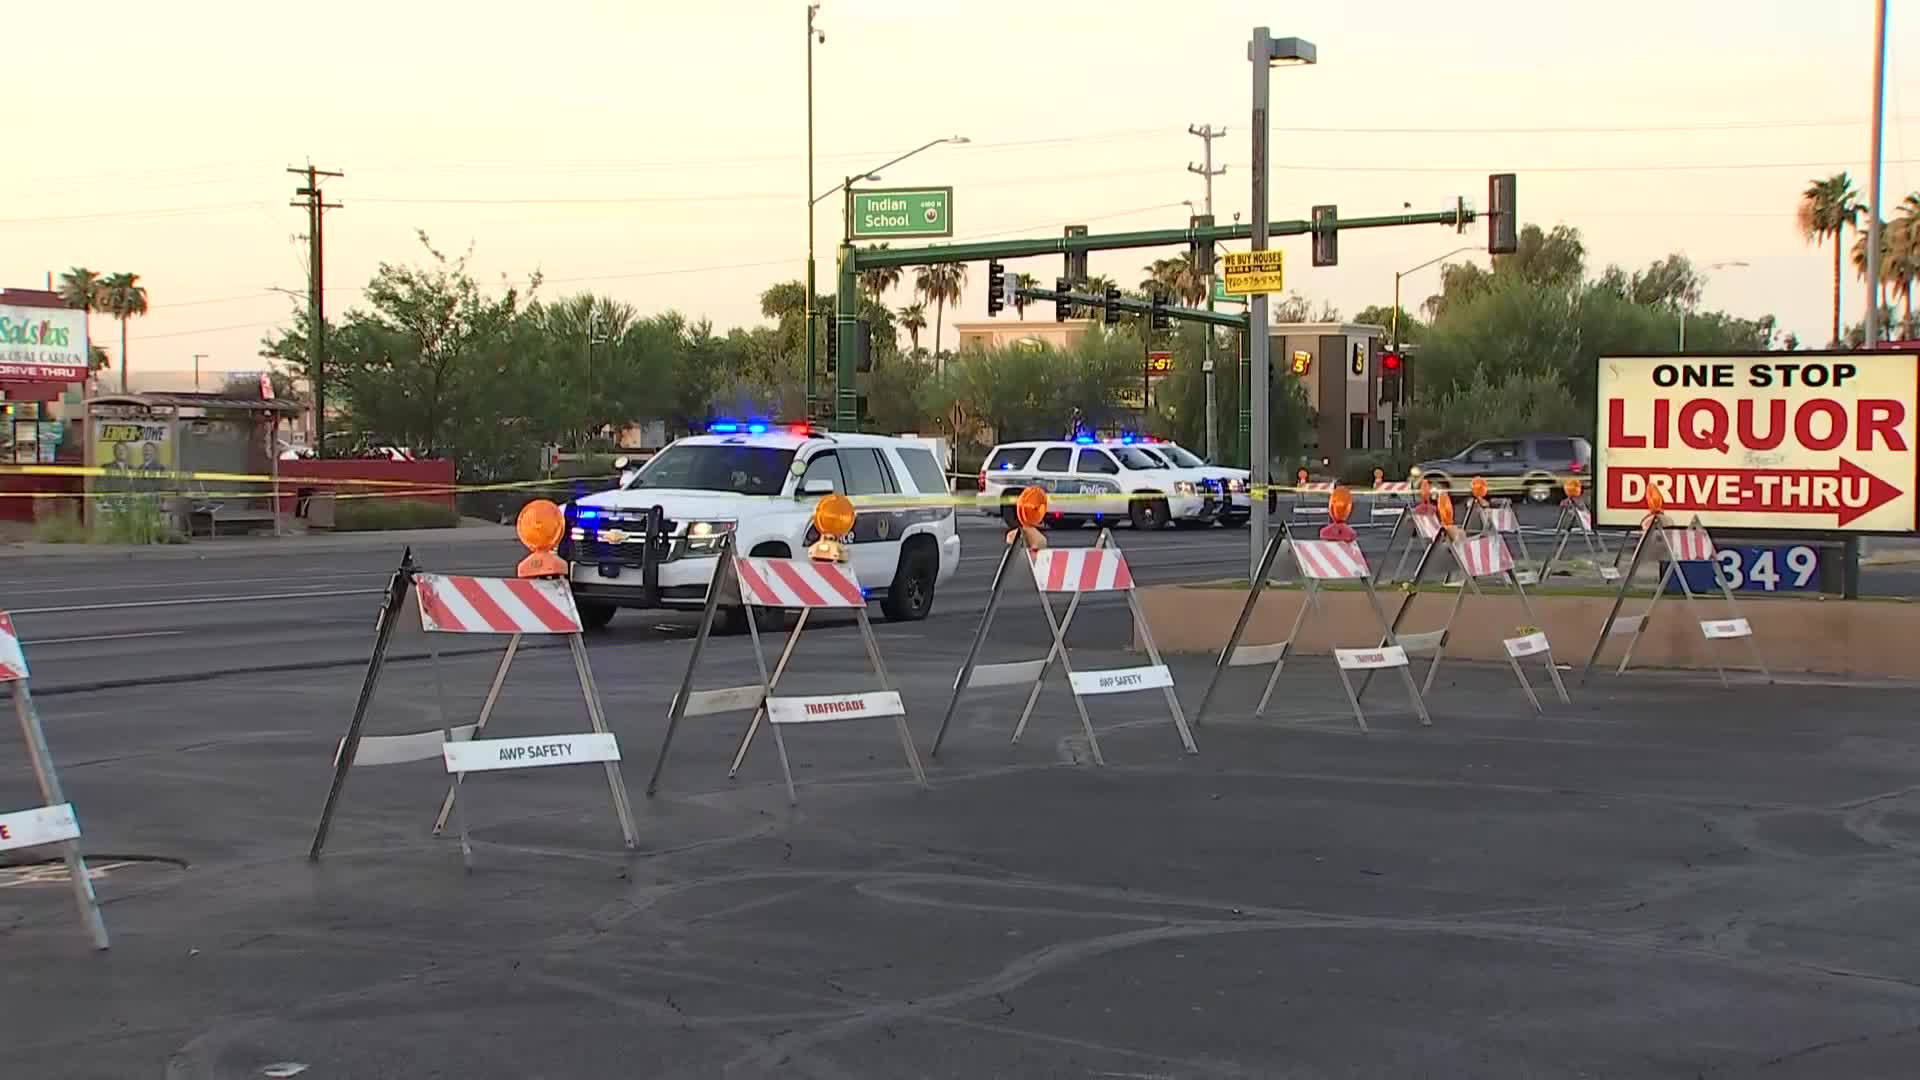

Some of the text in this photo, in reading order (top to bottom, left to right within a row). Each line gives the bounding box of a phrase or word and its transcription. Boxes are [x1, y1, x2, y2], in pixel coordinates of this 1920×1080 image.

[867, 198, 907, 212] Indian
[865, 213, 910, 228] School
[1225, 251, 1281, 265] WE BUY HOUSES
[0, 365, 76, 377] DRIVE THRU
[1652, 364, 1857, 388] ONE STOP
[1608, 397, 1908, 455] LIQUOR
[1080, 483, 1107, 496] Police
[1621, 473, 1870, 508] DRIVE-THRU
[1713, 545, 1818, 592] 349
[1114, 674, 1142, 686] SAFETY
[804, 699, 866, 715] TRAFFICADE
[499, 743, 572, 761] AWP SAFETY
